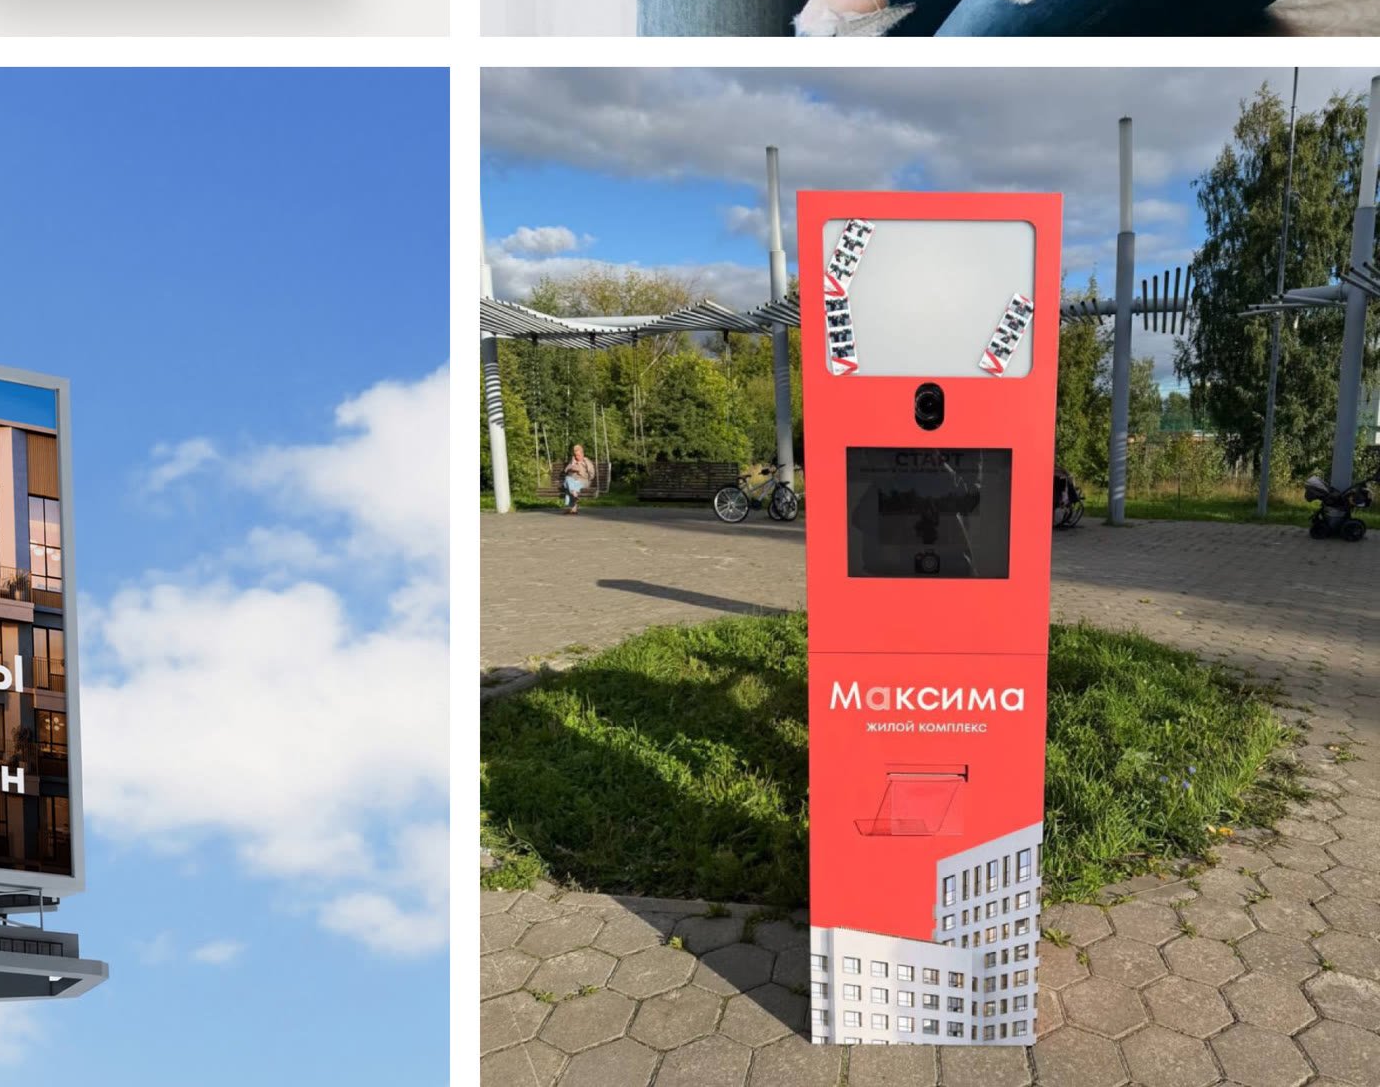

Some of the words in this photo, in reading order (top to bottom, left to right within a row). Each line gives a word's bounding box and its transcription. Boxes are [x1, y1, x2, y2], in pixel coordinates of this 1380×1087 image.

[829, 681, 1025, 712] Максима
[866, 720, 915, 733] ЖИЛОЙ
[919, 722, 988, 734] КОМПЛЕКС
